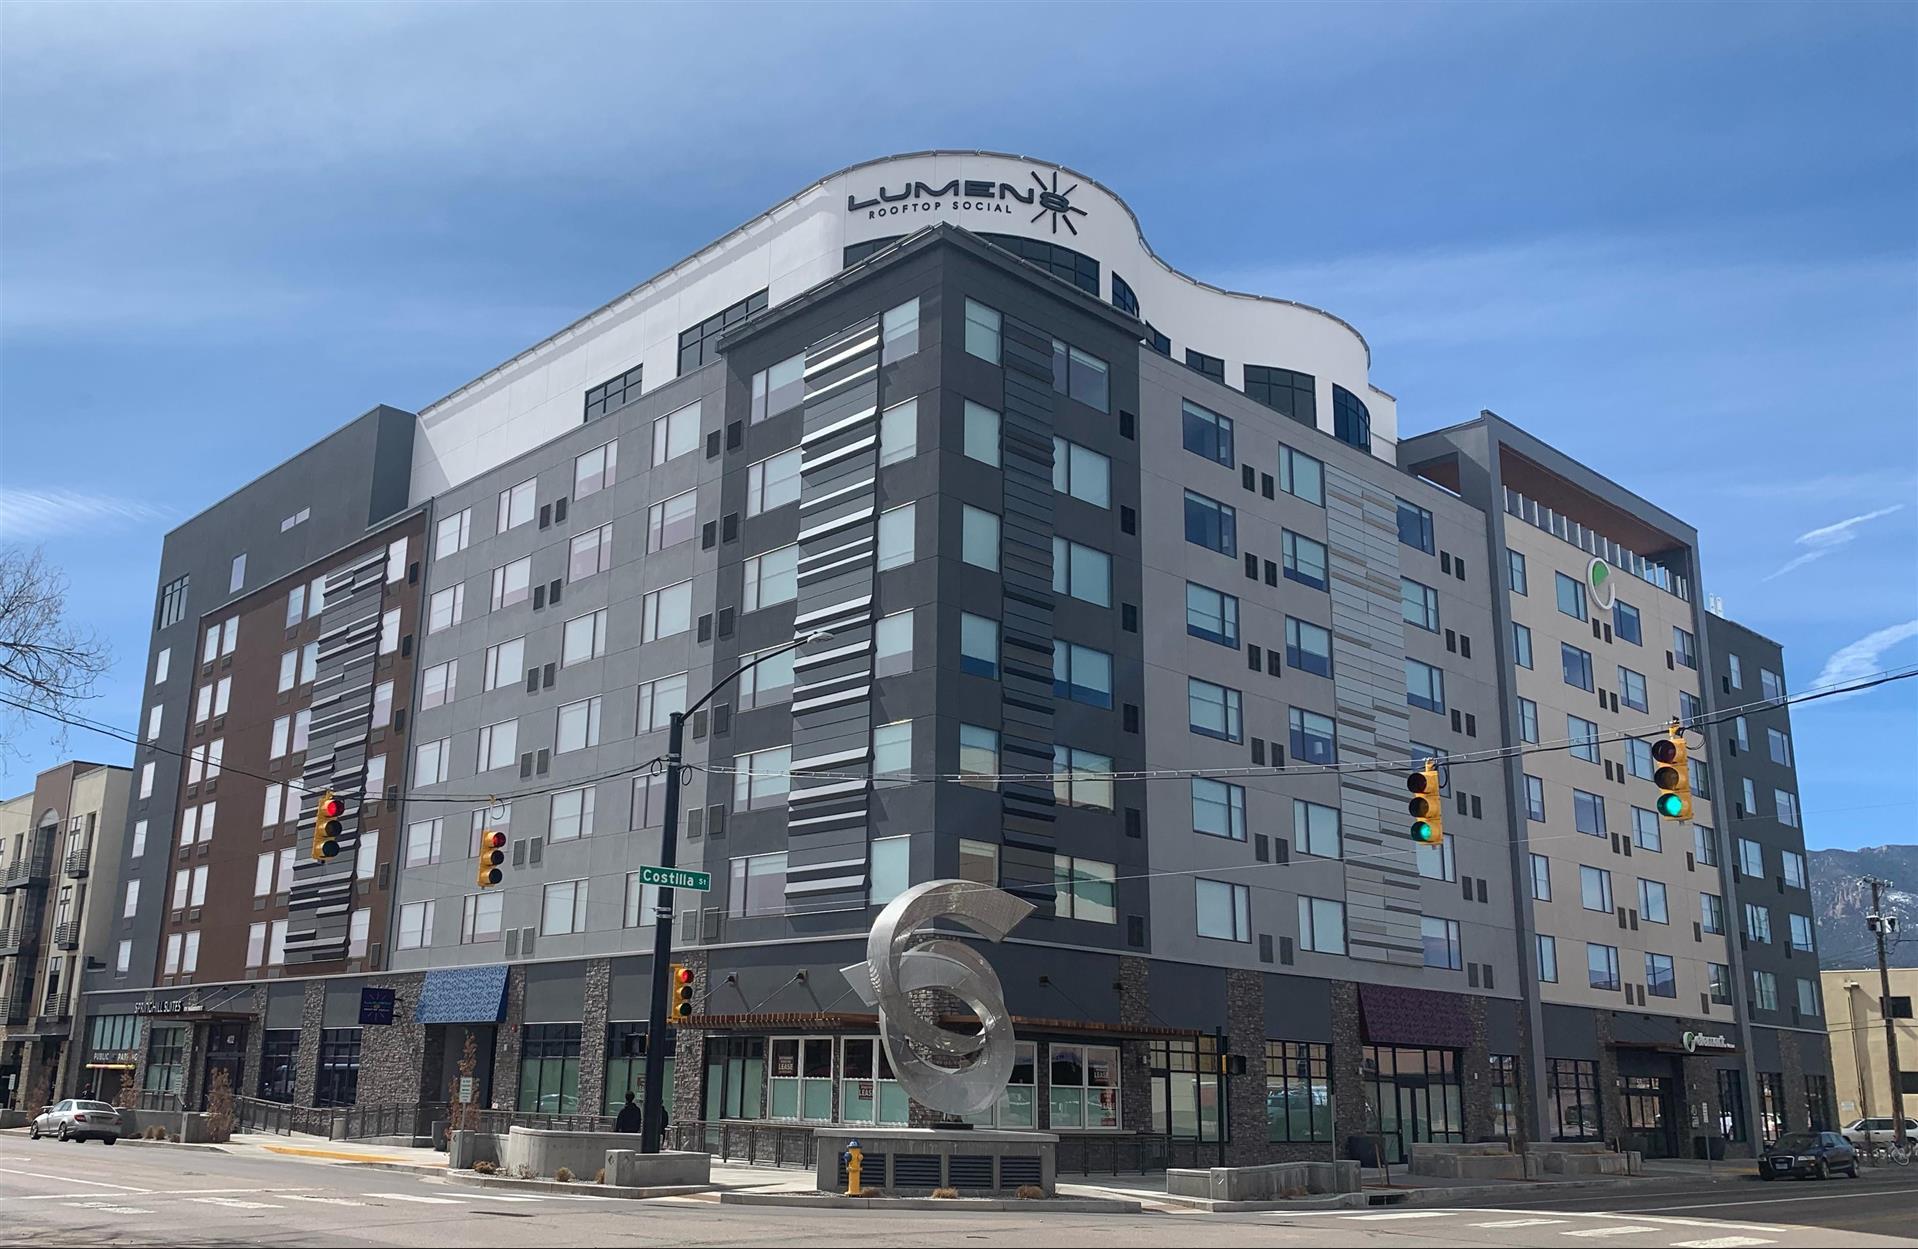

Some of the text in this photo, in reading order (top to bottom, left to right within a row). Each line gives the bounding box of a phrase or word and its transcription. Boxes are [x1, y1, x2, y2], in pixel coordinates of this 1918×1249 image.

[868, 201, 1012, 220] ROOFTOP SOCIAL
[643, 869, 694, 886] Costilla
[859, 1088, 873, 1096] LEAS
